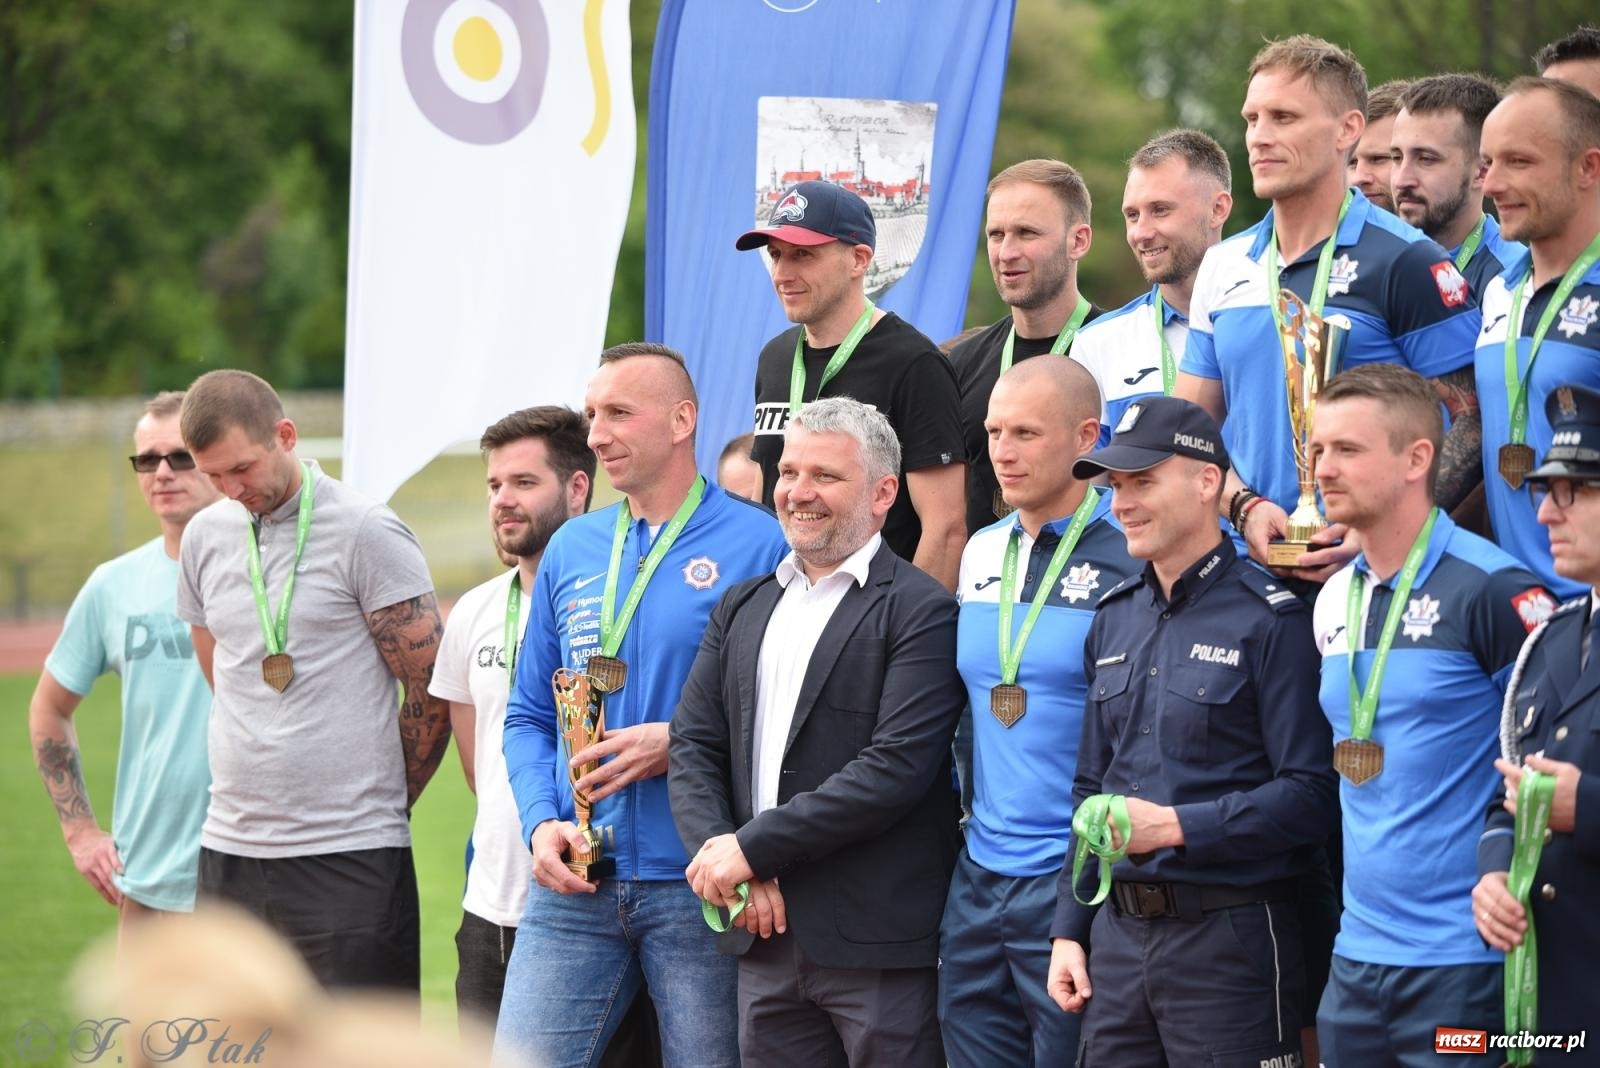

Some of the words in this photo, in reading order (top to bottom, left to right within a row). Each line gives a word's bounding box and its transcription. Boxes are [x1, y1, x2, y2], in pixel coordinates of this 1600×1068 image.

[1173, 432, 1215, 455] POLICJA
[1198, 555, 1221, 578] POLICJA
[1189, 643, 1240, 666] POLICJA
